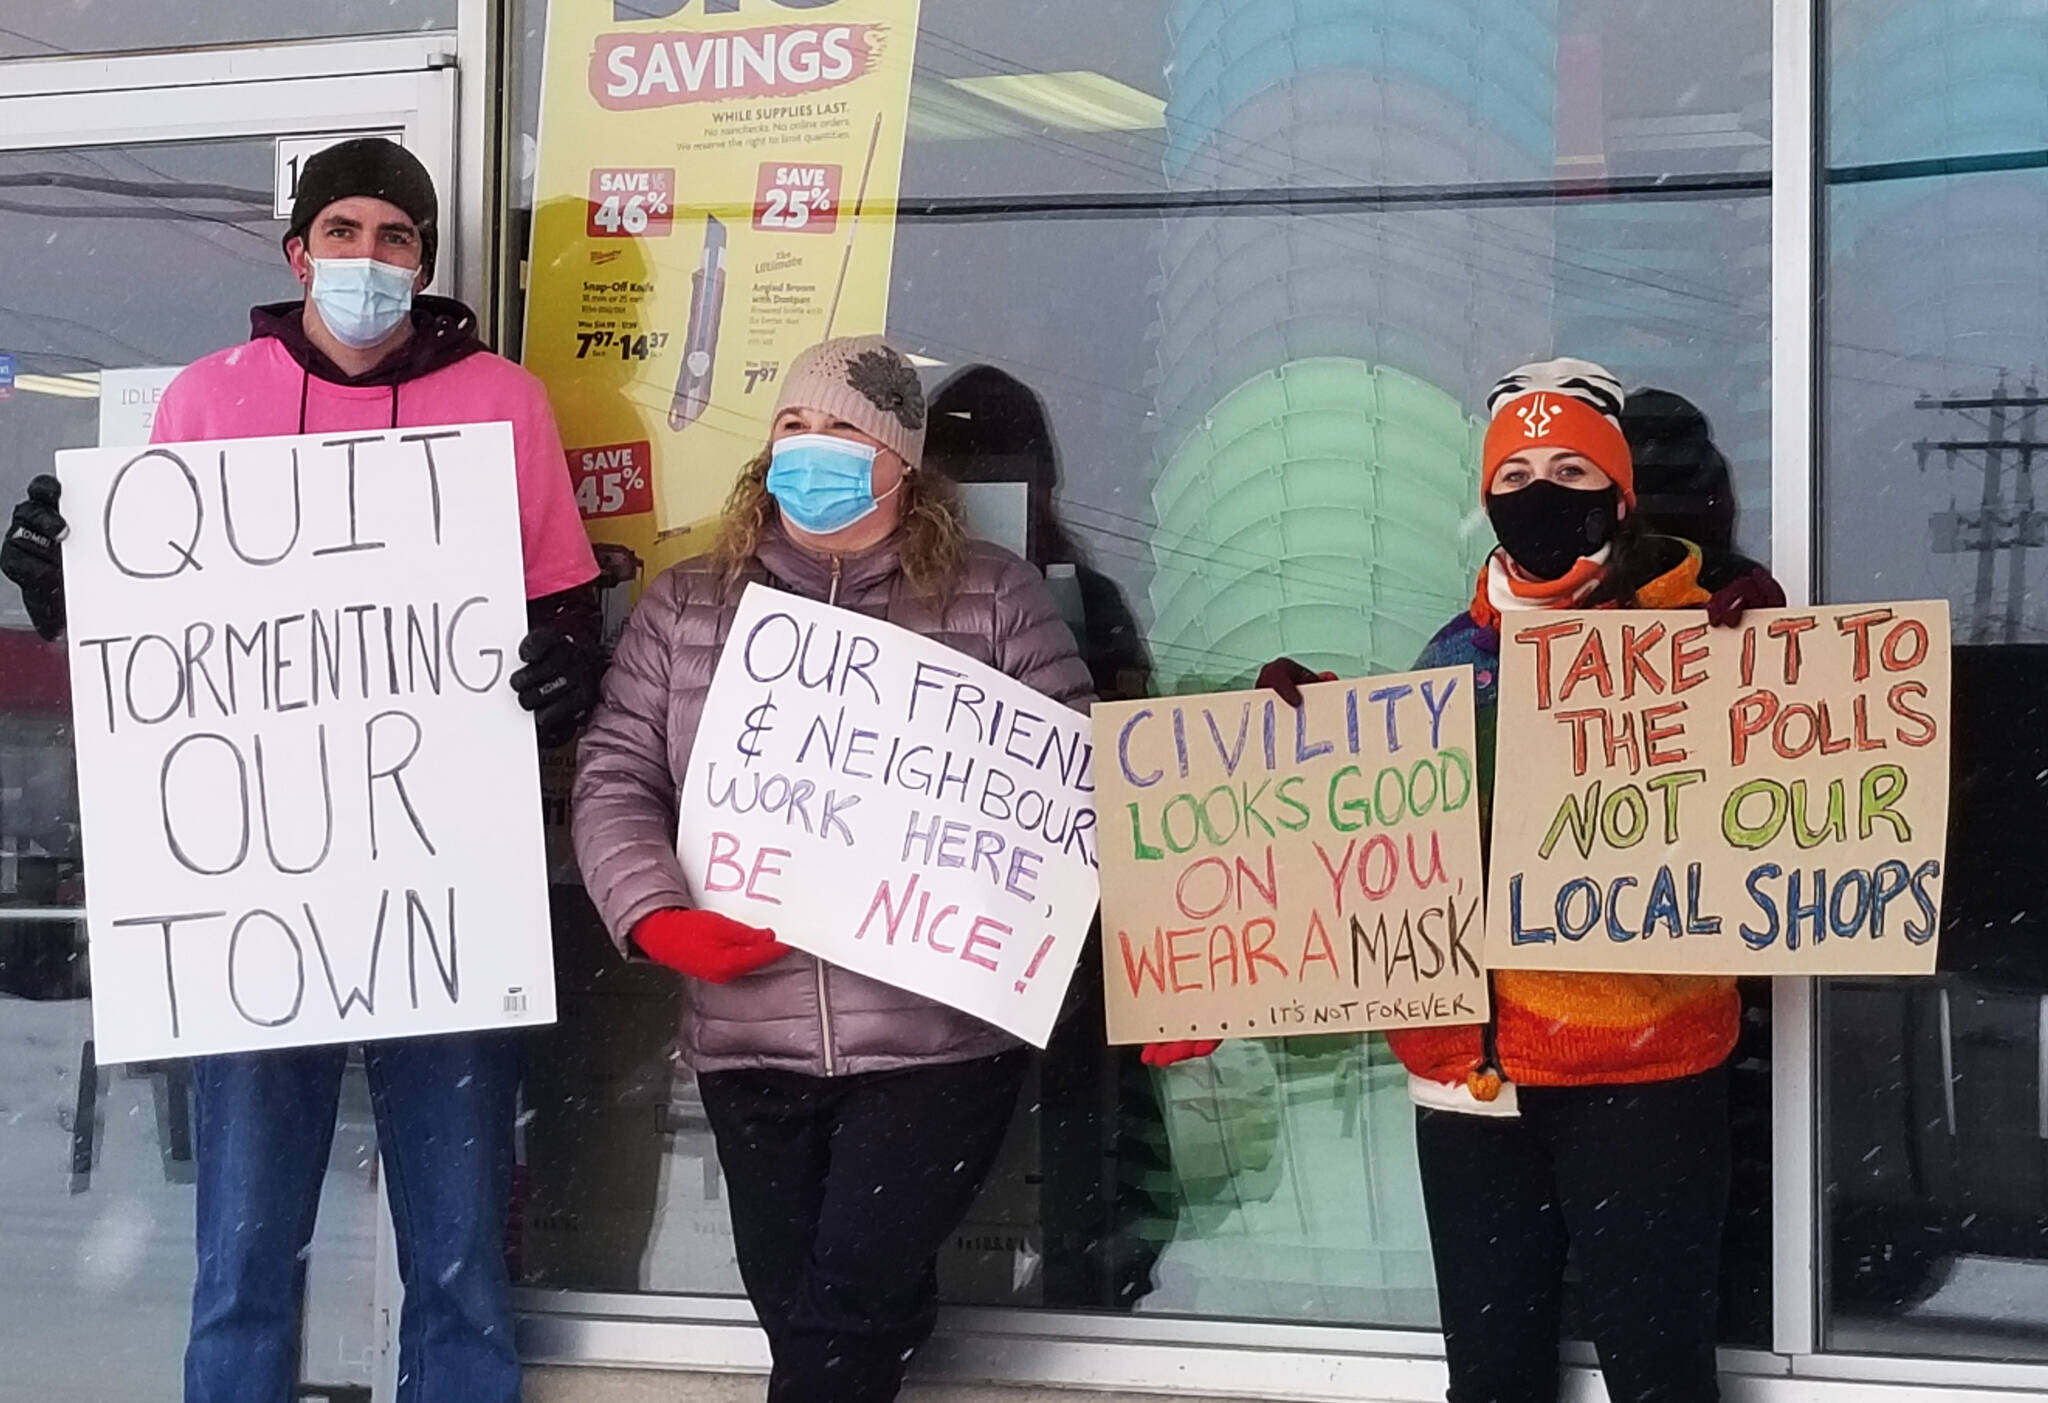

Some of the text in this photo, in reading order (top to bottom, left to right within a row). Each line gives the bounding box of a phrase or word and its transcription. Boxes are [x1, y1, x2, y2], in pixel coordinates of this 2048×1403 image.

[606, 28, 853, 98] SAVINGS
[712, 109, 752, 123] WHILE
[756, 105, 813, 120] SUPPLIES
[594, 191, 668, 234] 46%
[599, 173, 649, 191] SAVE
[761, 187, 830, 228] 25%
[776, 167, 825, 186] SAVE
[583, 281, 628, 294] Snap-Off
[122, 388, 160, 405] IDLE
[575, 466, 645, 514] 45%
[582, 448, 633, 471] SAVE
[104, 431, 461, 579] QUIT
[80, 596, 503, 733] TORMENTING
[744, 612, 881, 704] OUR
[1515, 608, 1929, 710] TAKE IT TO
[1118, 678, 1458, 787] CIVILITY
[1554, 681, 1936, 776] THE POLLS
[160, 710, 436, 875] OUR
[707, 762, 861, 846] WORK
[737, 689, 1099, 869] & NEIGHBOUR
[1126, 746, 1473, 860] LOOKS GOOD
[1538, 764, 1911, 860] NOT OUR
[704, 832, 792, 905] BE
[1176, 845, 1278, 920] ON
[1509, 859, 1940, 951] LOCAL SHOPS
[112, 887, 459, 1039] TOWN
[1119, 895, 1480, 998] WEAR A MASK
[1270, 999, 1305, 1026] IT'S
[1314, 1000, 1359, 1024] NOT
[1367, 992, 1475, 1021] FOREVER
